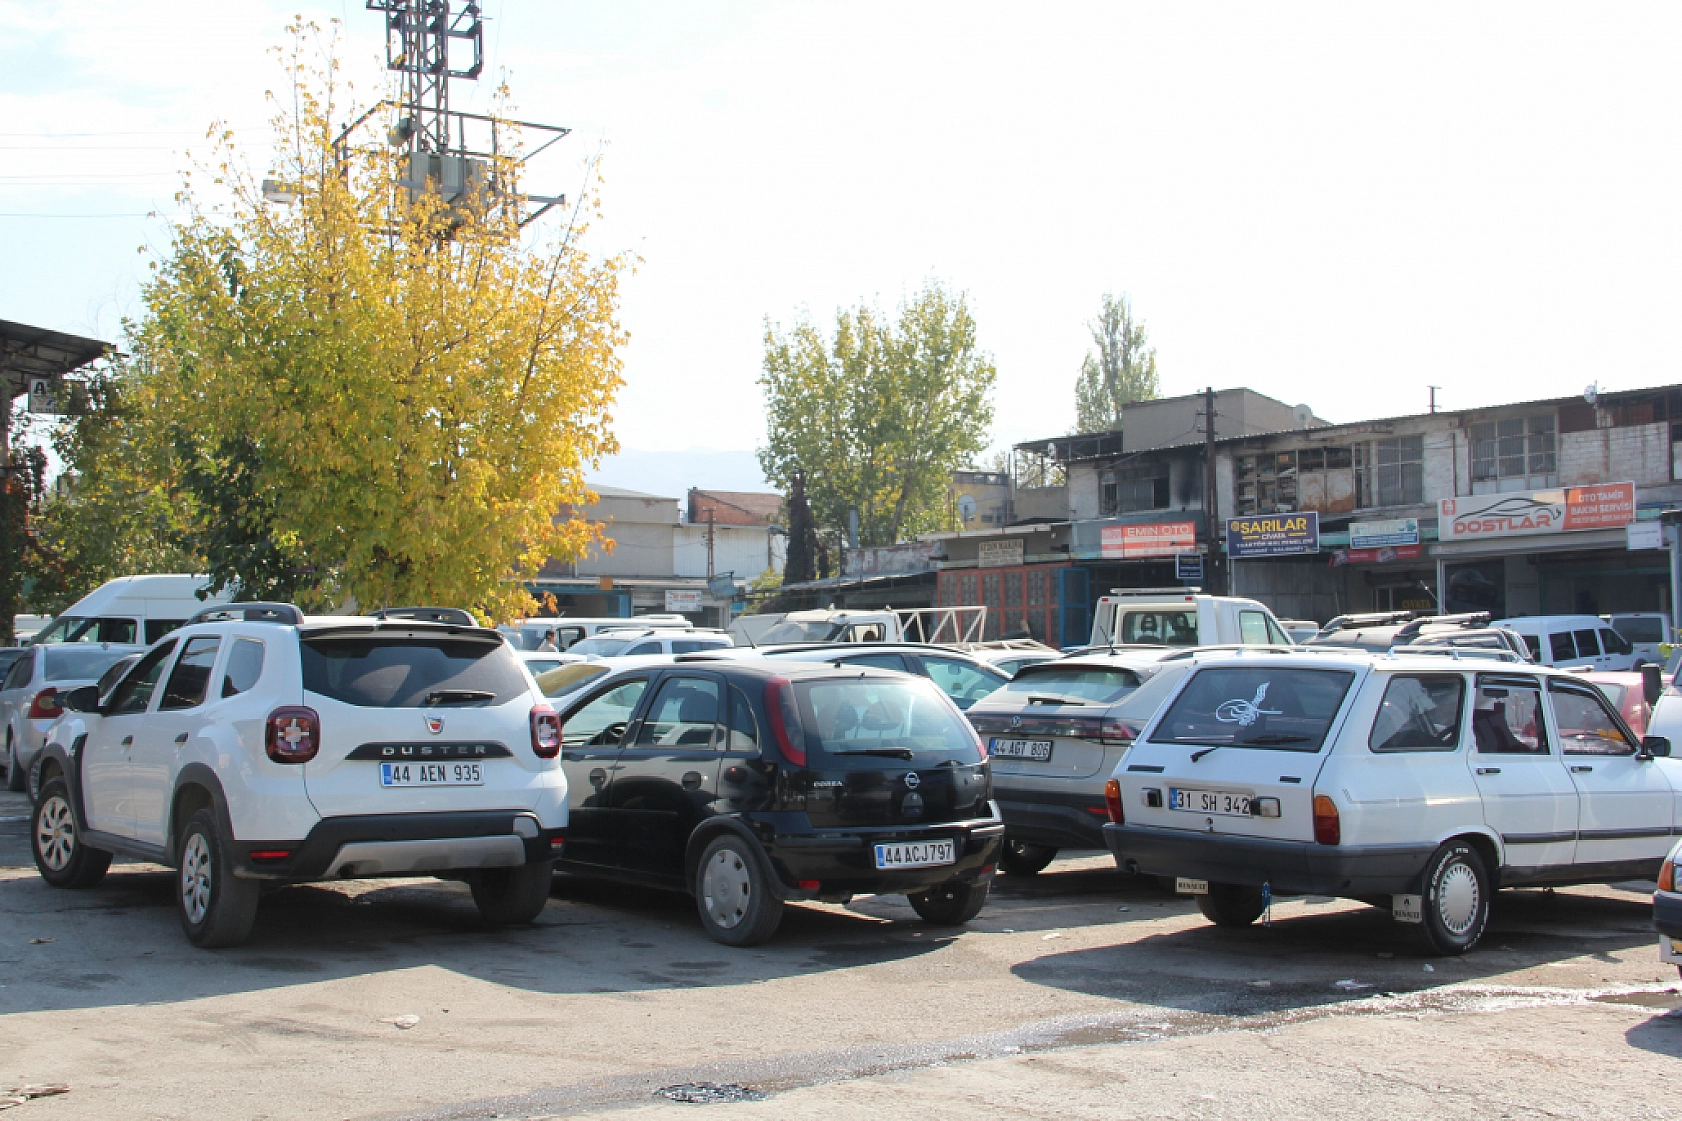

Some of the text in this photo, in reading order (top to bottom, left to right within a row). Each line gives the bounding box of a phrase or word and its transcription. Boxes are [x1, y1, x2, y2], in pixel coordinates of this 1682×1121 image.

[1579, 490, 1624, 503] OTO TAMİR
[1571, 506, 1597, 516] BAKIM
[1162, 524, 1190, 534] OTO
[1241, 518, 1307, 534] SARILAR
[1454, 515, 1551, 534] DOSTLAR
[382, 745, 486, 756] DUSTER
[1009, 742, 1027, 755] AGT
[393, 765, 480, 781] 44 AEN 935
[1178, 792, 1250, 814] 31 SH 342
[886, 847, 902, 864] 44
